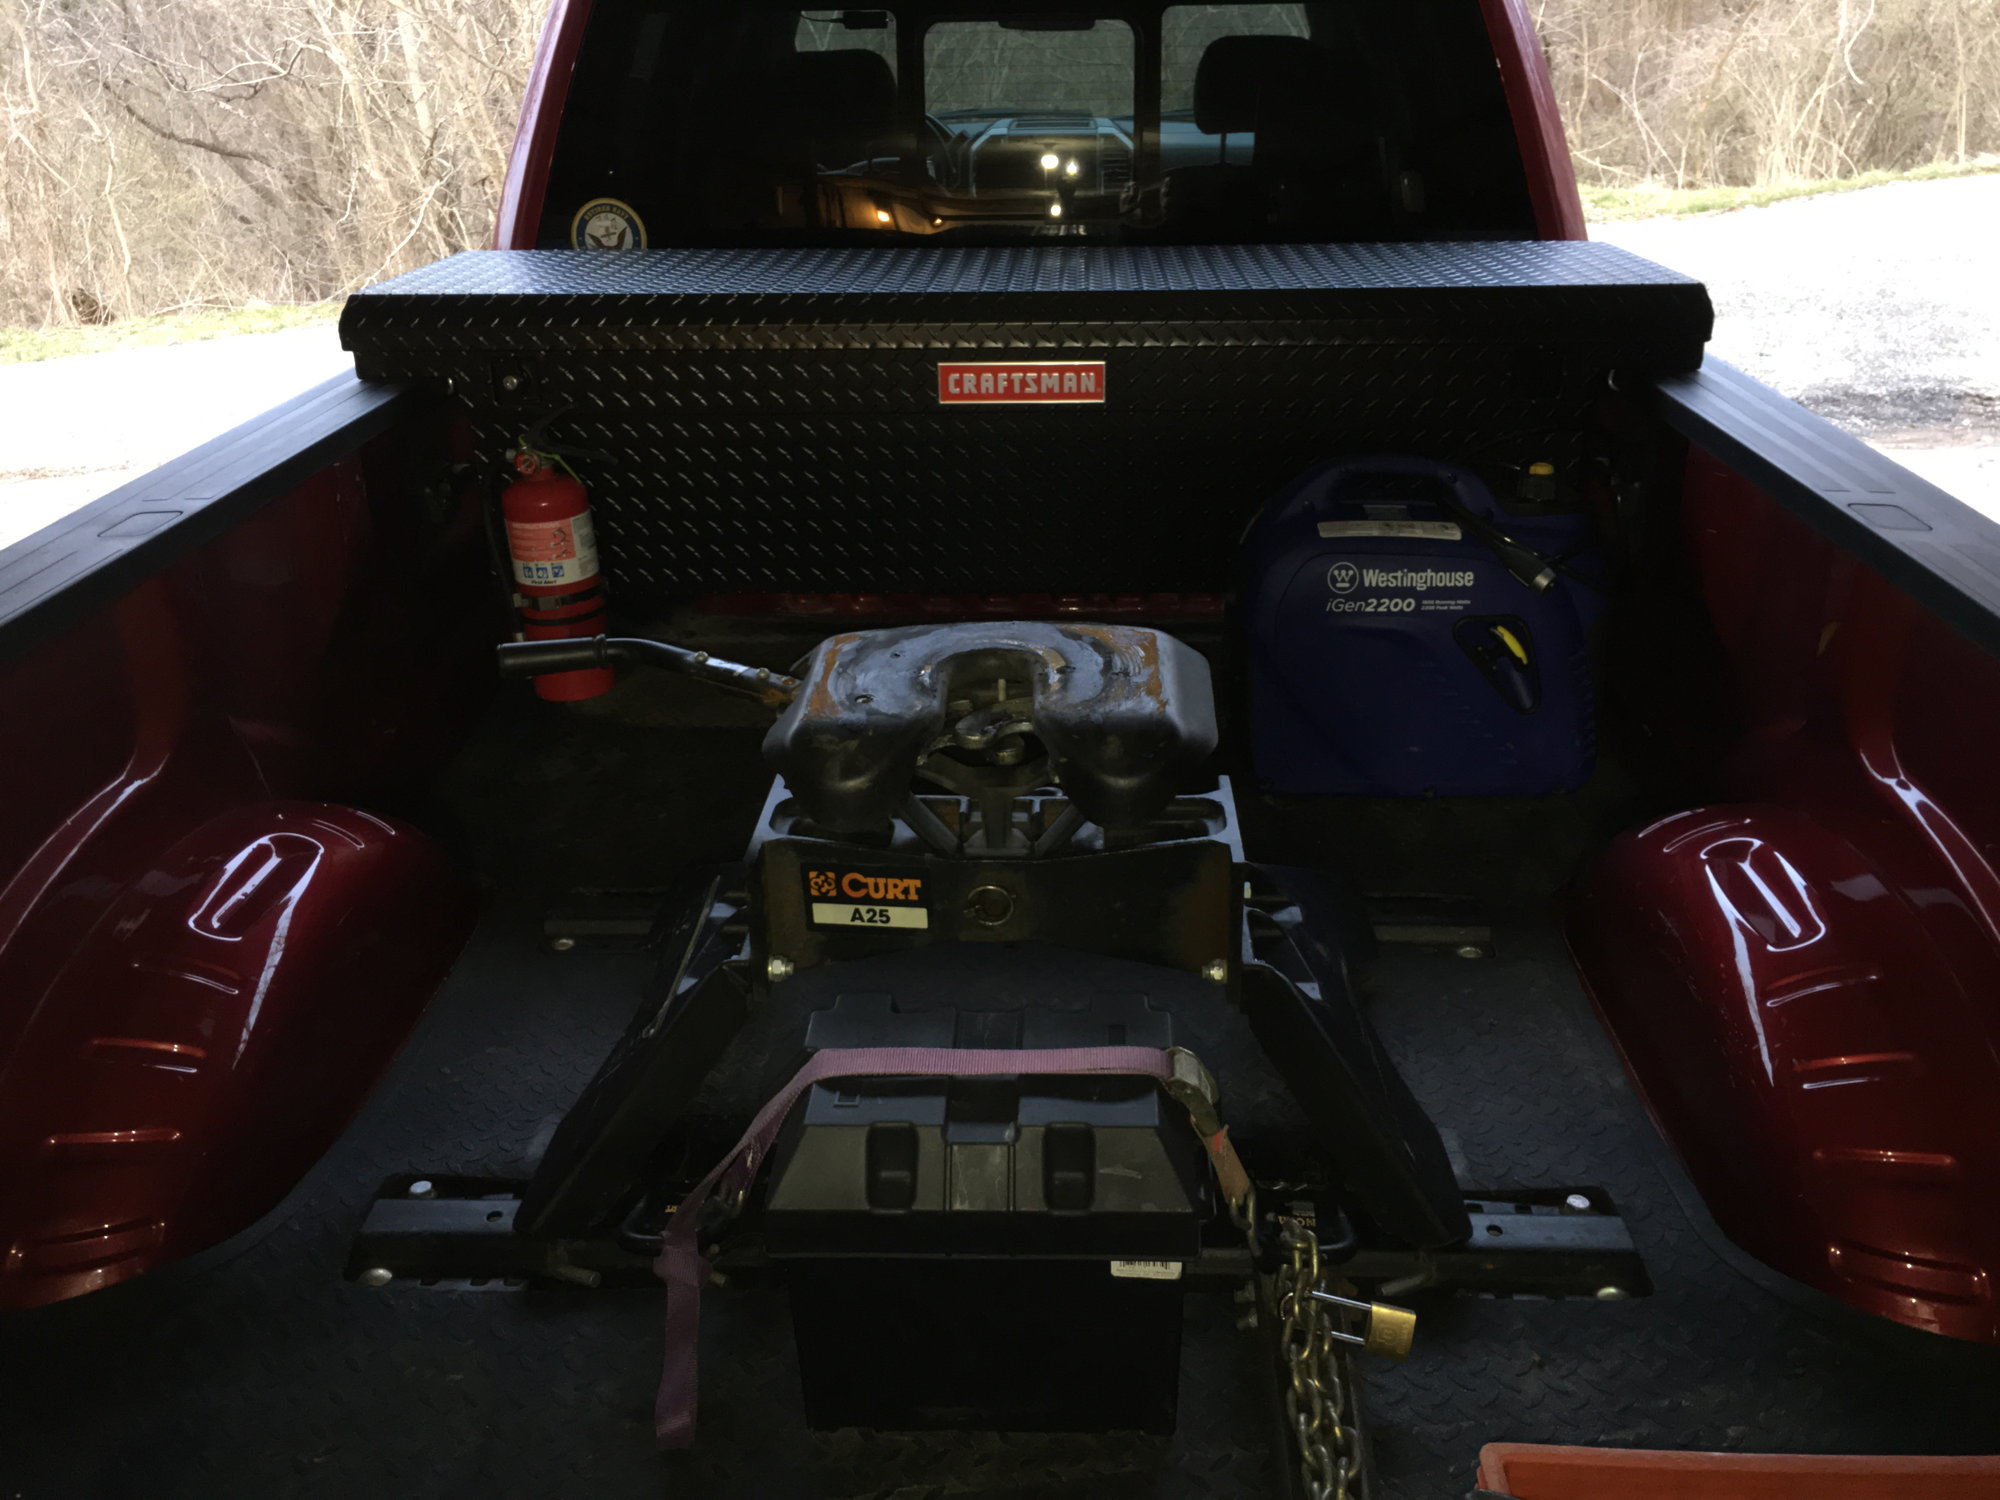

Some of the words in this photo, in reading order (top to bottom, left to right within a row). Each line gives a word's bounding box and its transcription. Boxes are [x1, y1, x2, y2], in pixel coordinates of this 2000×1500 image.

[948, 371, 1096, 394] CRAFTSMAN
[1362, 568, 1475, 591] Westinghouse
[1326, 598, 1416, 613] iGen2200
[841, 872, 922, 900] CURT
[850, 907, 891, 924] A25
